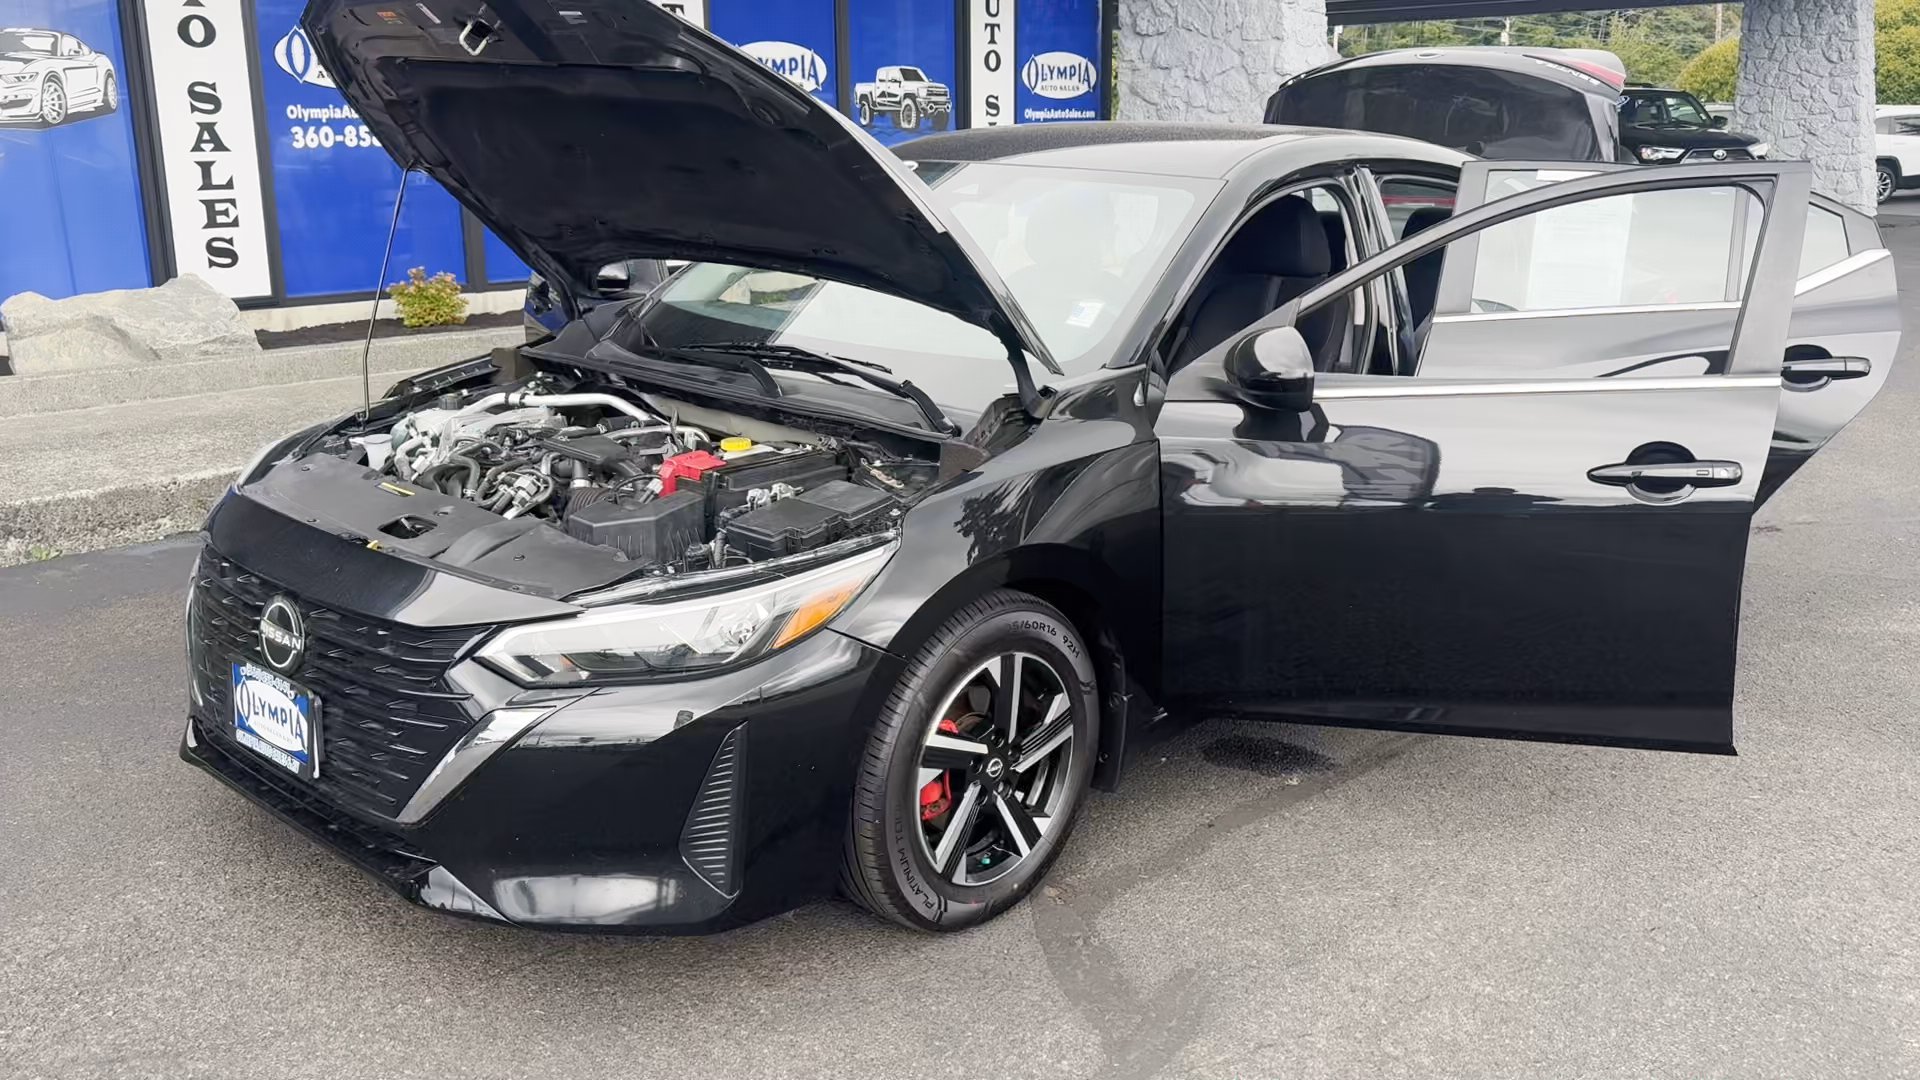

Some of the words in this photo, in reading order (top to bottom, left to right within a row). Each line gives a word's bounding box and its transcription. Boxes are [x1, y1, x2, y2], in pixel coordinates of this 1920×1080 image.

[1026, 57, 1092, 91] OLYMPIA
[187, 81, 240, 269] SALES
[259, 619, 302, 650] NISSAN
[1062, 635, 1080, 659] 92H
[239, 678, 308, 754] OLYMPIA
[897, 847, 936, 909] PLATINUM
